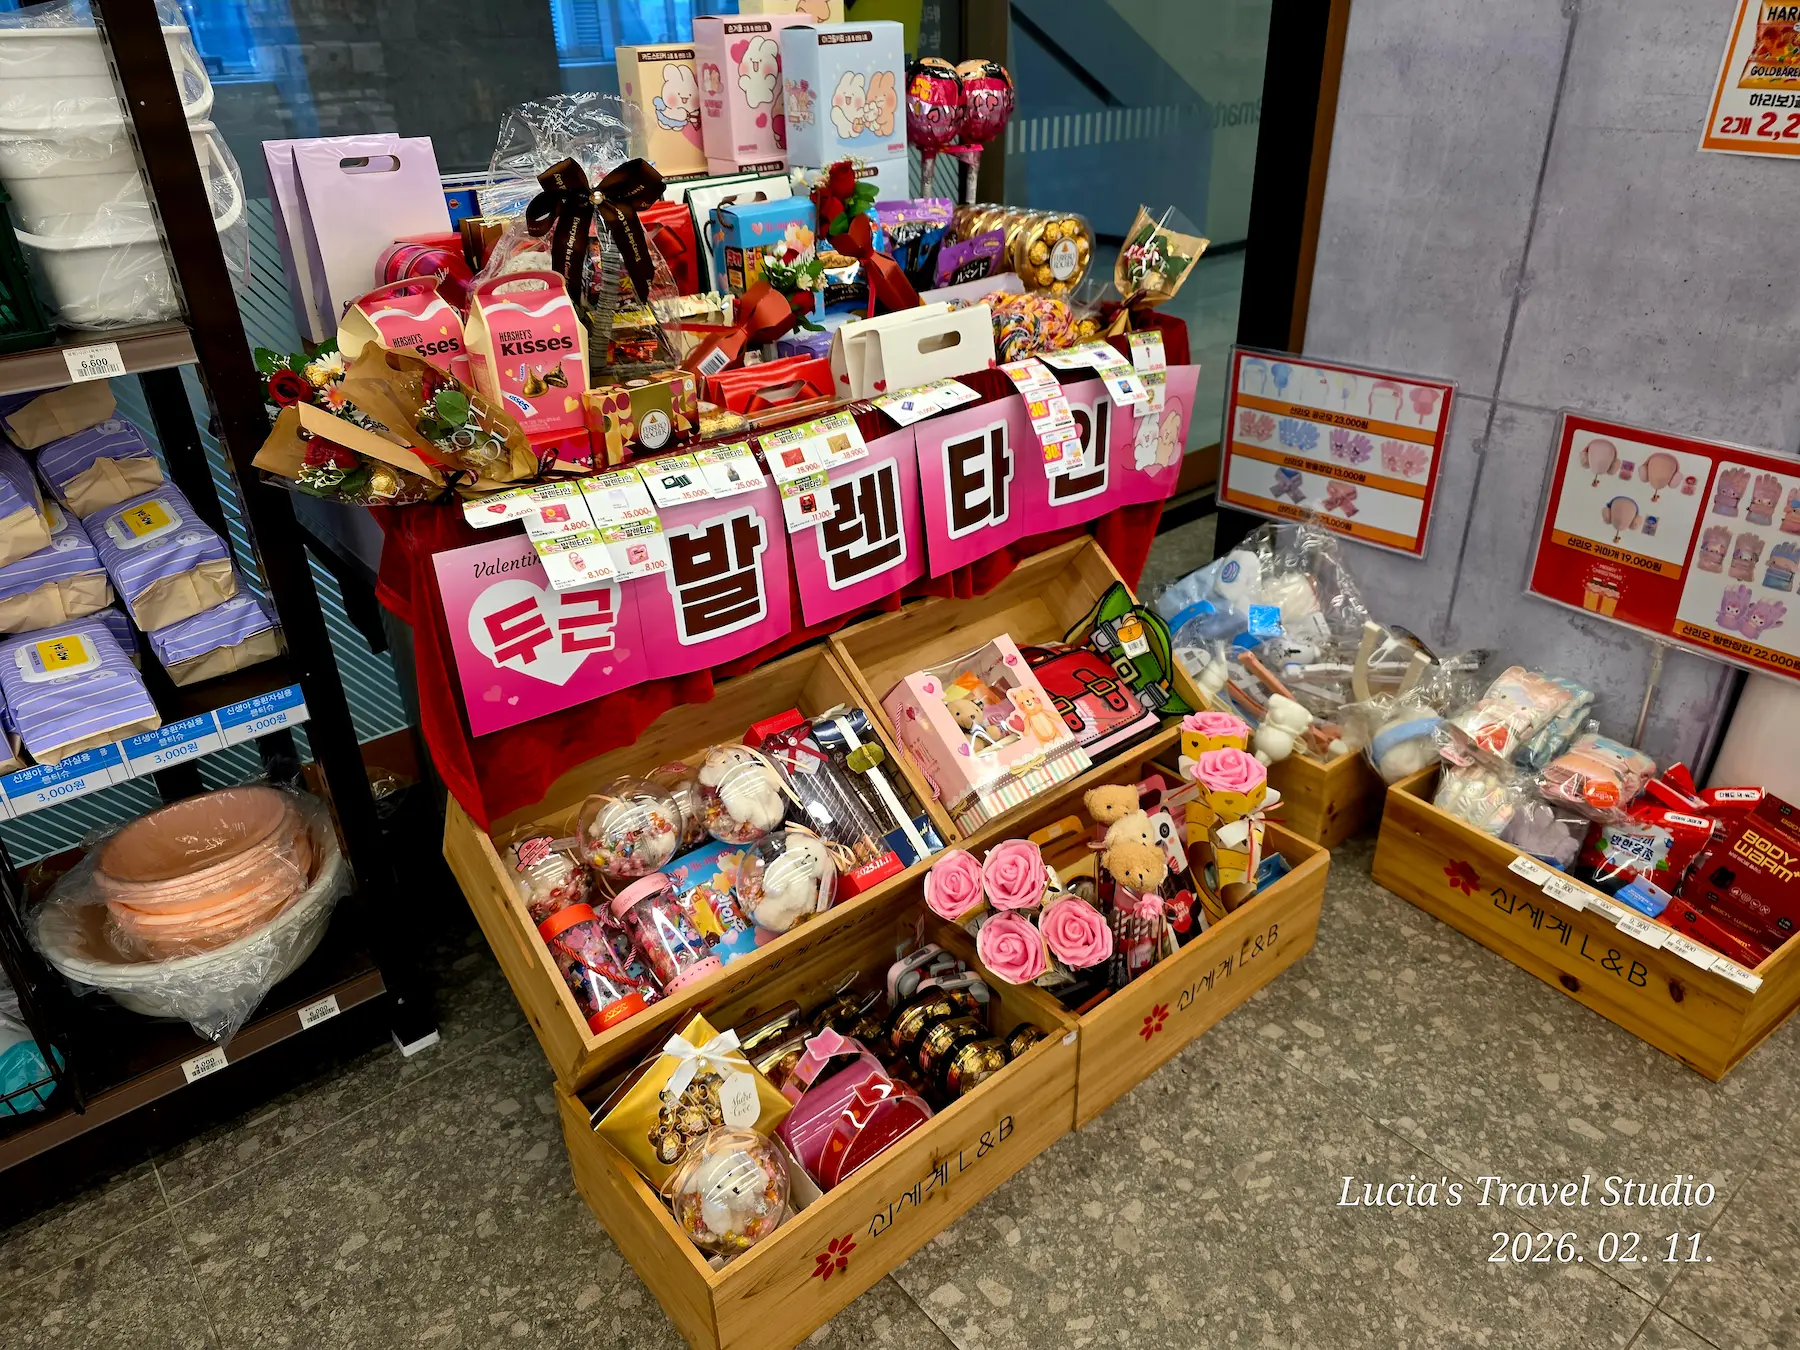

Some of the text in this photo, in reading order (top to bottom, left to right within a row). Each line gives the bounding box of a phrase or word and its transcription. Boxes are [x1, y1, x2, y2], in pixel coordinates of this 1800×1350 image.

[1720, 116, 1752, 135] 2개
[499, 329, 532, 342] HERSHEY'S
[1567, 537, 1592, 551] 산리오
[1594, 544, 1619, 561] 귀마개
[483, 588, 614, 665] 두근
[1683, 625, 1710, 641] 산리오
[1713, 636, 1752, 655] 방한장갑
[226, 702, 252, 716] 신생아
[246, 712, 288, 734] 3,000원
[132, 730, 159, 746] 신생아
[154, 742, 199, 764] 3,000원
[13, 768, 42, 784] 신생아
[36, 779, 87, 802] 3,000원
[1741, 829, 1799, 866] BODY
[1490, 888, 1572, 946] 신세계
[1177, 955, 1234, 1011] 신세계
[868, 1161, 948, 1238] 신세계
